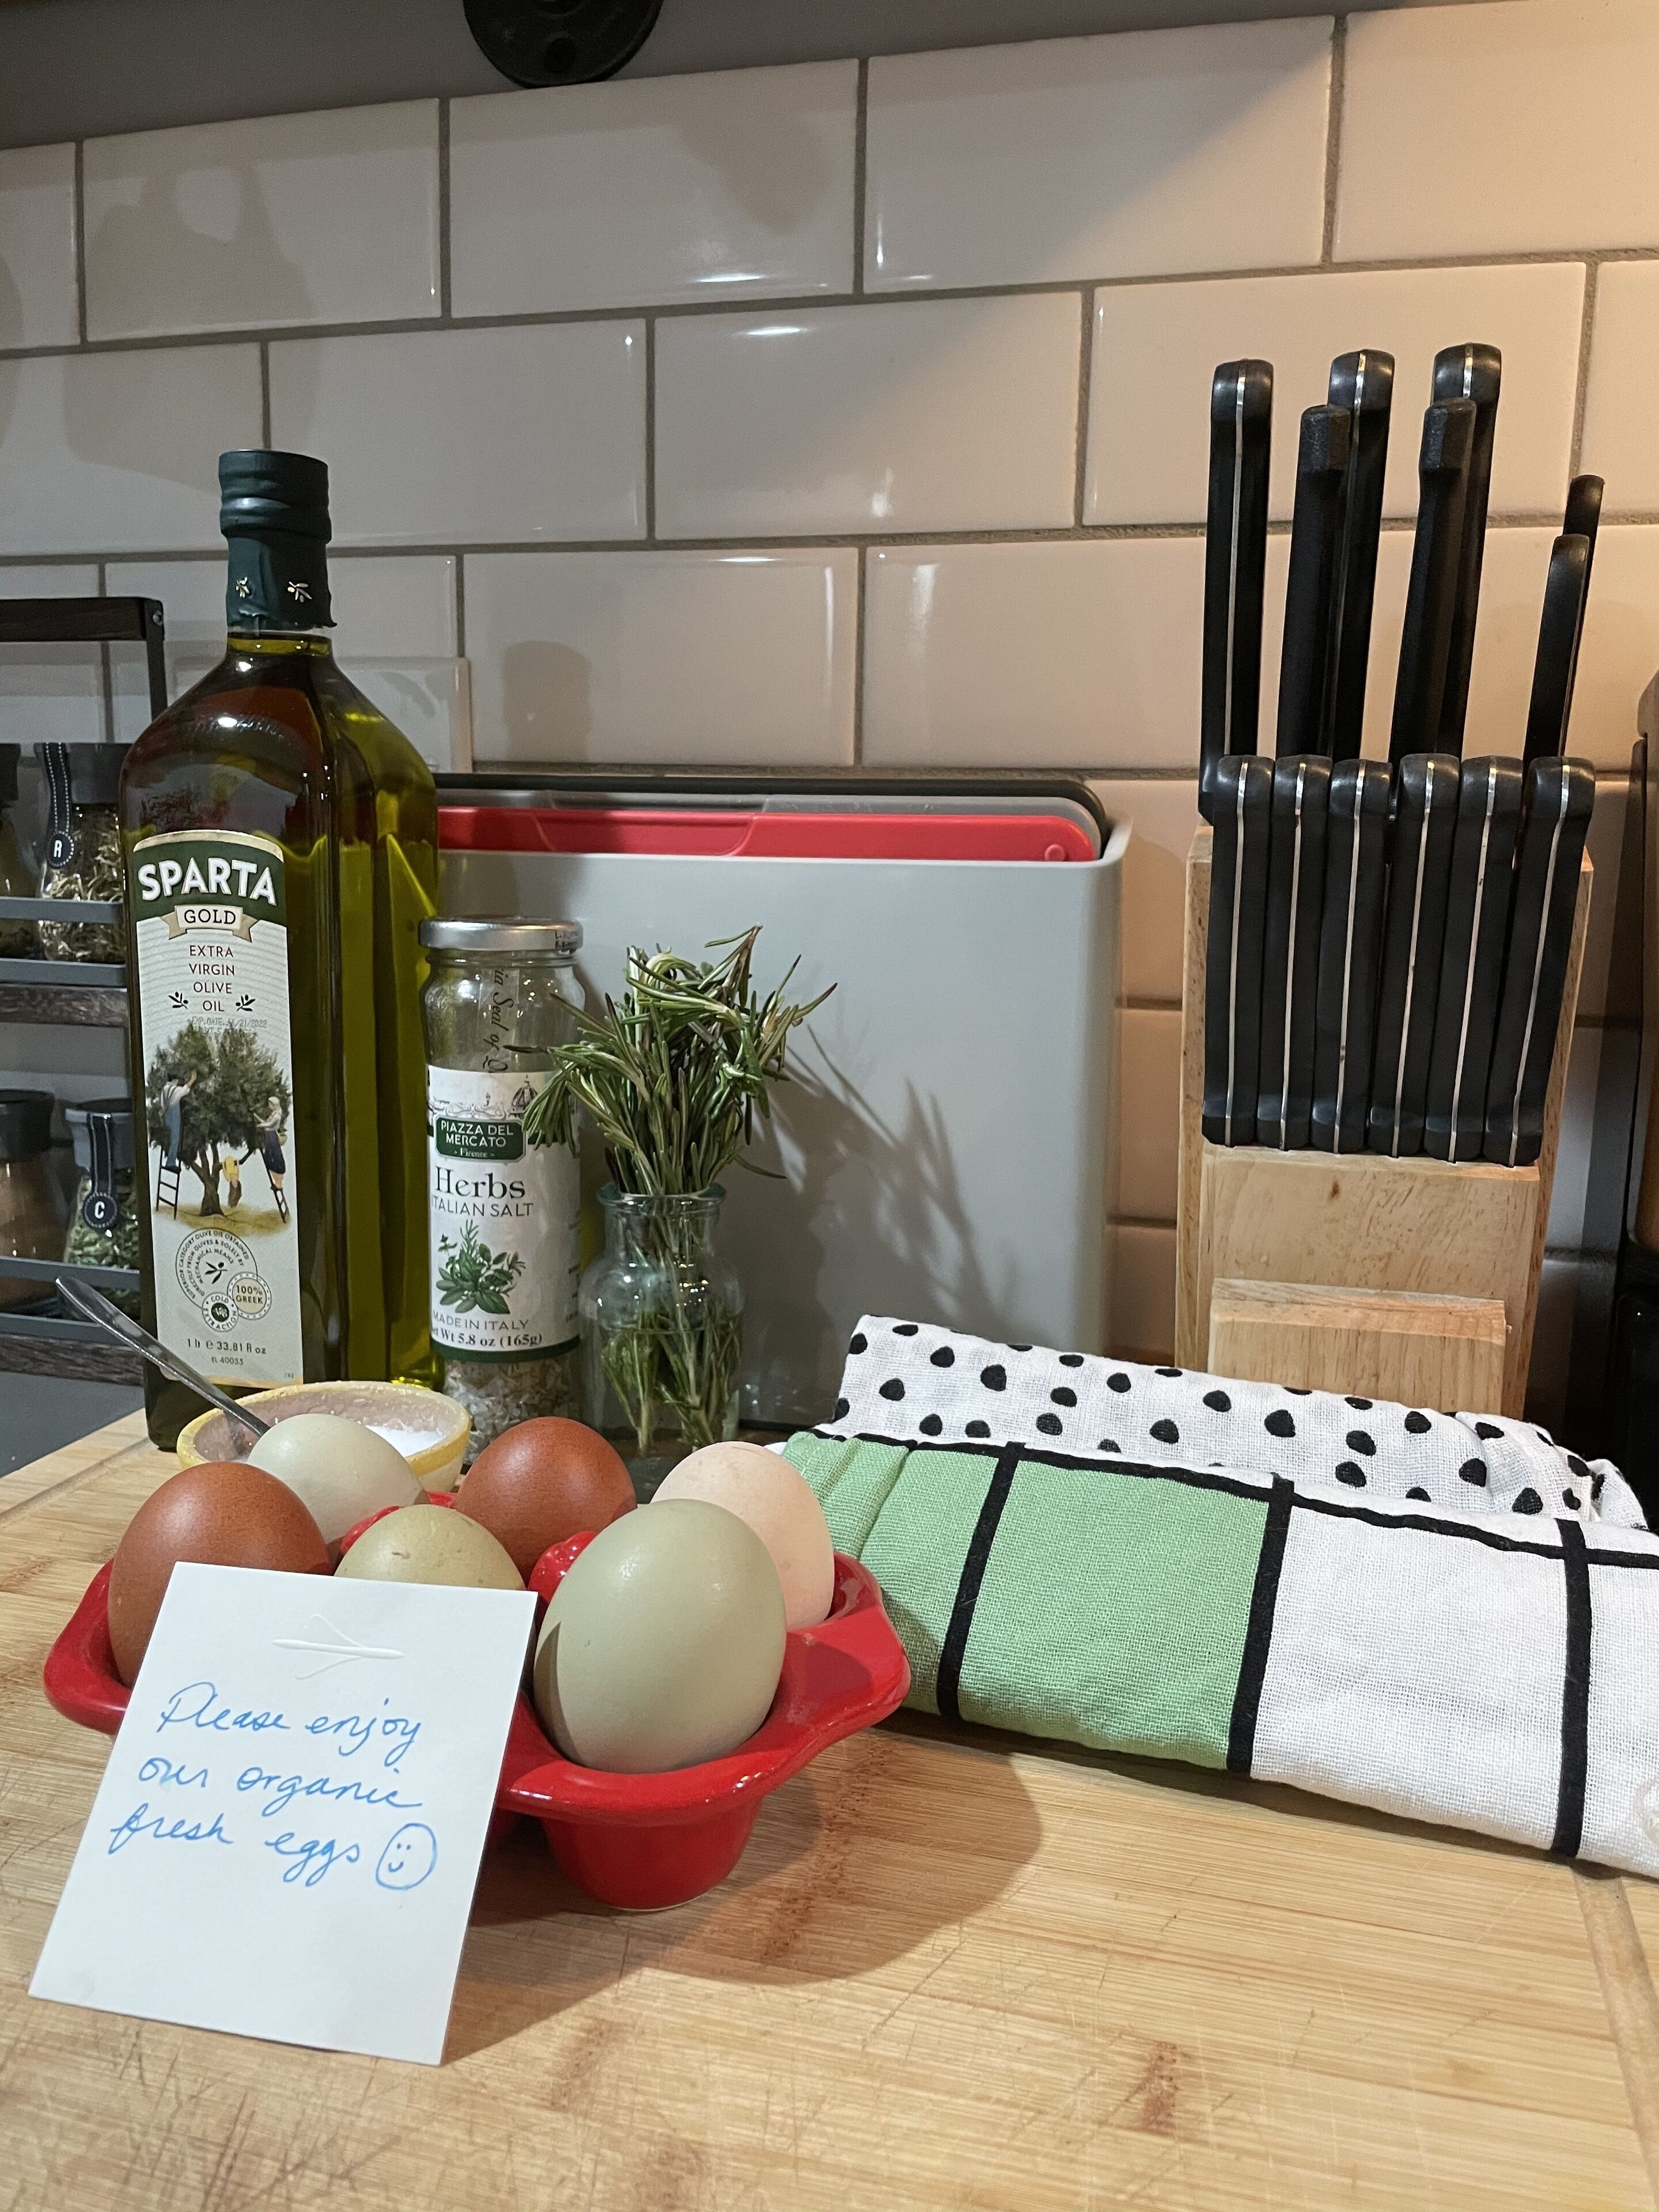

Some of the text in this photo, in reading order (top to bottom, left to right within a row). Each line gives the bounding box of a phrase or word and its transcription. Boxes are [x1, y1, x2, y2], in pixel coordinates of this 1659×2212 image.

[53, 839, 63, 858] R
[137, 857, 278, 907] SPARTA
[184, 908, 236, 925] GOLD
[189, 945, 234, 957] EXTRA
[189, 963, 235, 976] VIRGIN
[193, 981, 233, 994] OLIVE
[202, 999, 225, 1013] OIL
[491, 992, 514, 1032] Seal
[483, 1035, 501, 1051] of
[441, 1119, 514, 1136] PIAZZA DEL
[446, 1132, 506, 1147] MERCATO
[435, 1166, 525, 1199] Herbs
[94, 1200, 106, 1219] C
[431, 1194, 534, 1217] ITALIAN SALT
[211, 1294, 229, 1304] COLD
[236, 1285, 263, 1296] 100%
[236, 1295, 263, 1304] GREEK
[203, 1308, 237, 1330] EXTRACTION
[433, 1309, 529, 1331] MADE IN ITALY
[217, 1341, 243, 1352] 33.81
[441, 1327, 455, 1342] Wt
[458, 1333, 476, 1346] 5.8
[480, 1338, 496, 1347] oz
[500, 1333, 543, 1349] (165g)
[156, 1681, 422, 1767] Please enjoy
[138, 1756, 422, 1817] our organic
[108, 1802, 360, 1887] fresh eggs
